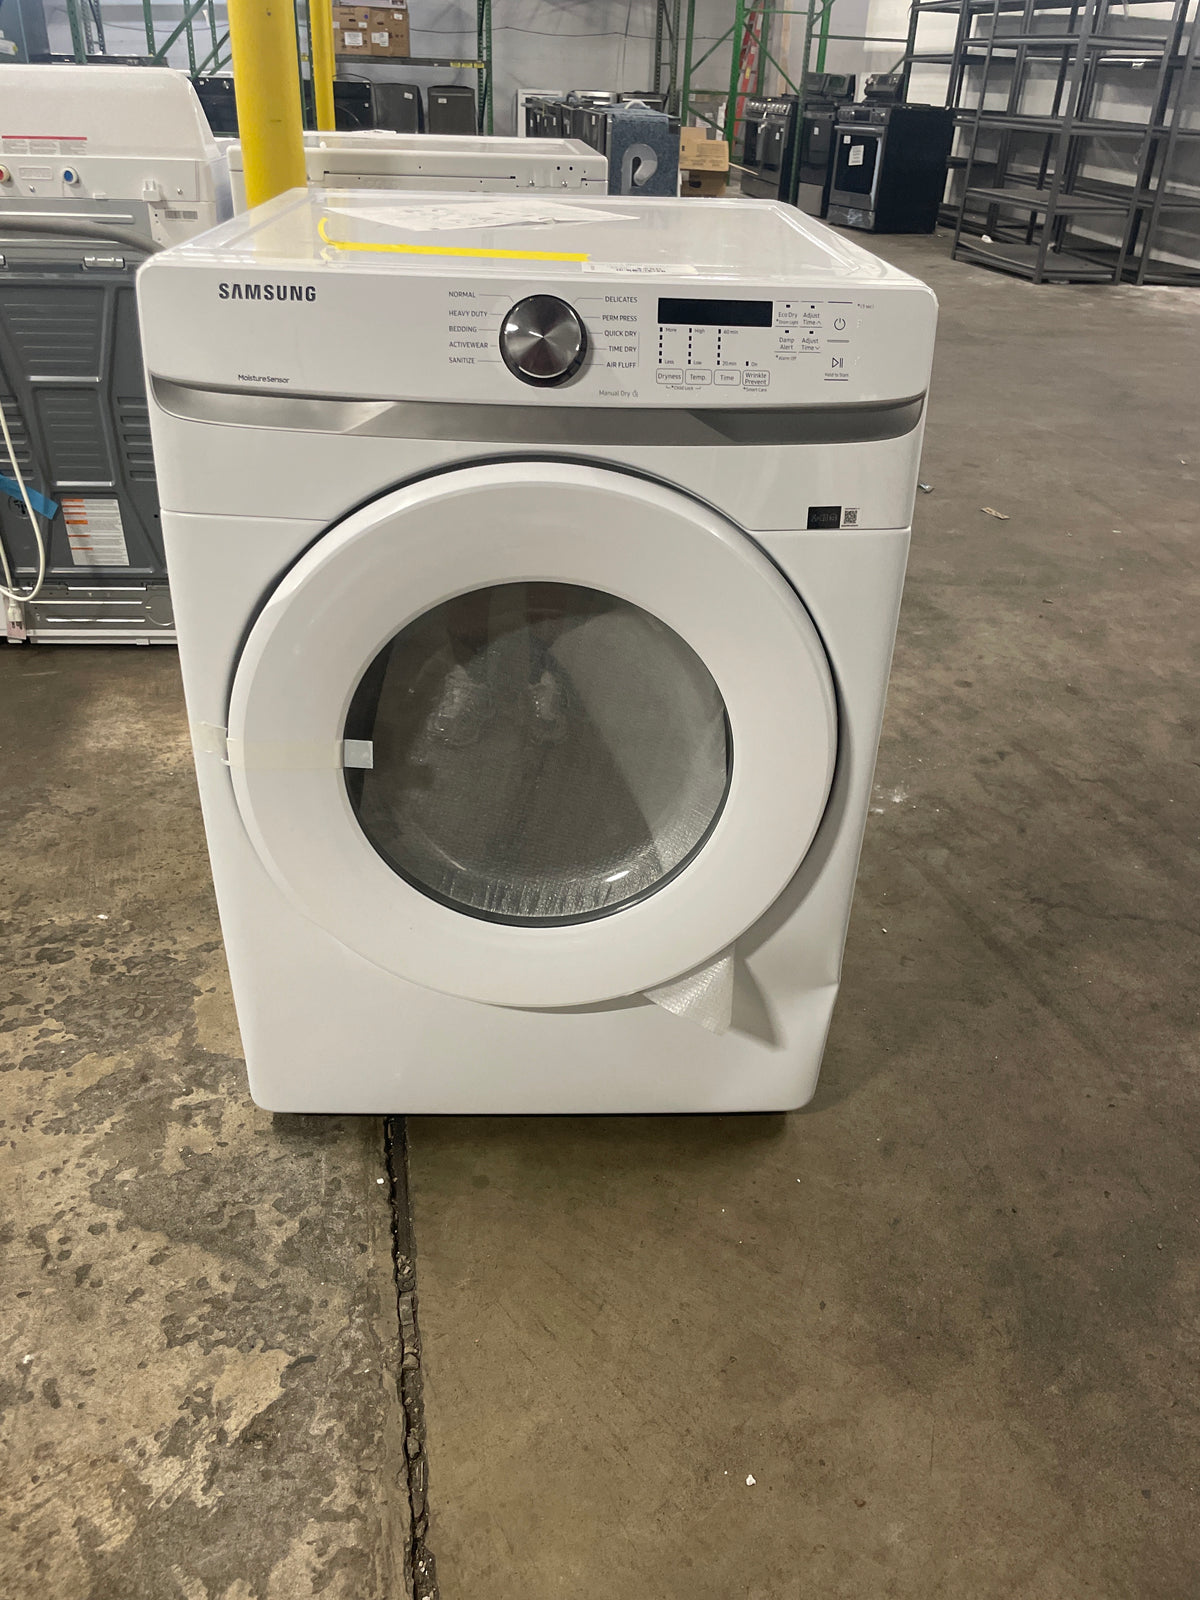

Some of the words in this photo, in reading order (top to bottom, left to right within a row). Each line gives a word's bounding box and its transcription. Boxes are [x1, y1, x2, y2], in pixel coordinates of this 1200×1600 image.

[218, 283, 316, 302] SAMSUNG
[657, 373, 681, 382] Dryness
[690, 373, 706, 381] Temp
[620, 390, 630, 398] Dry
